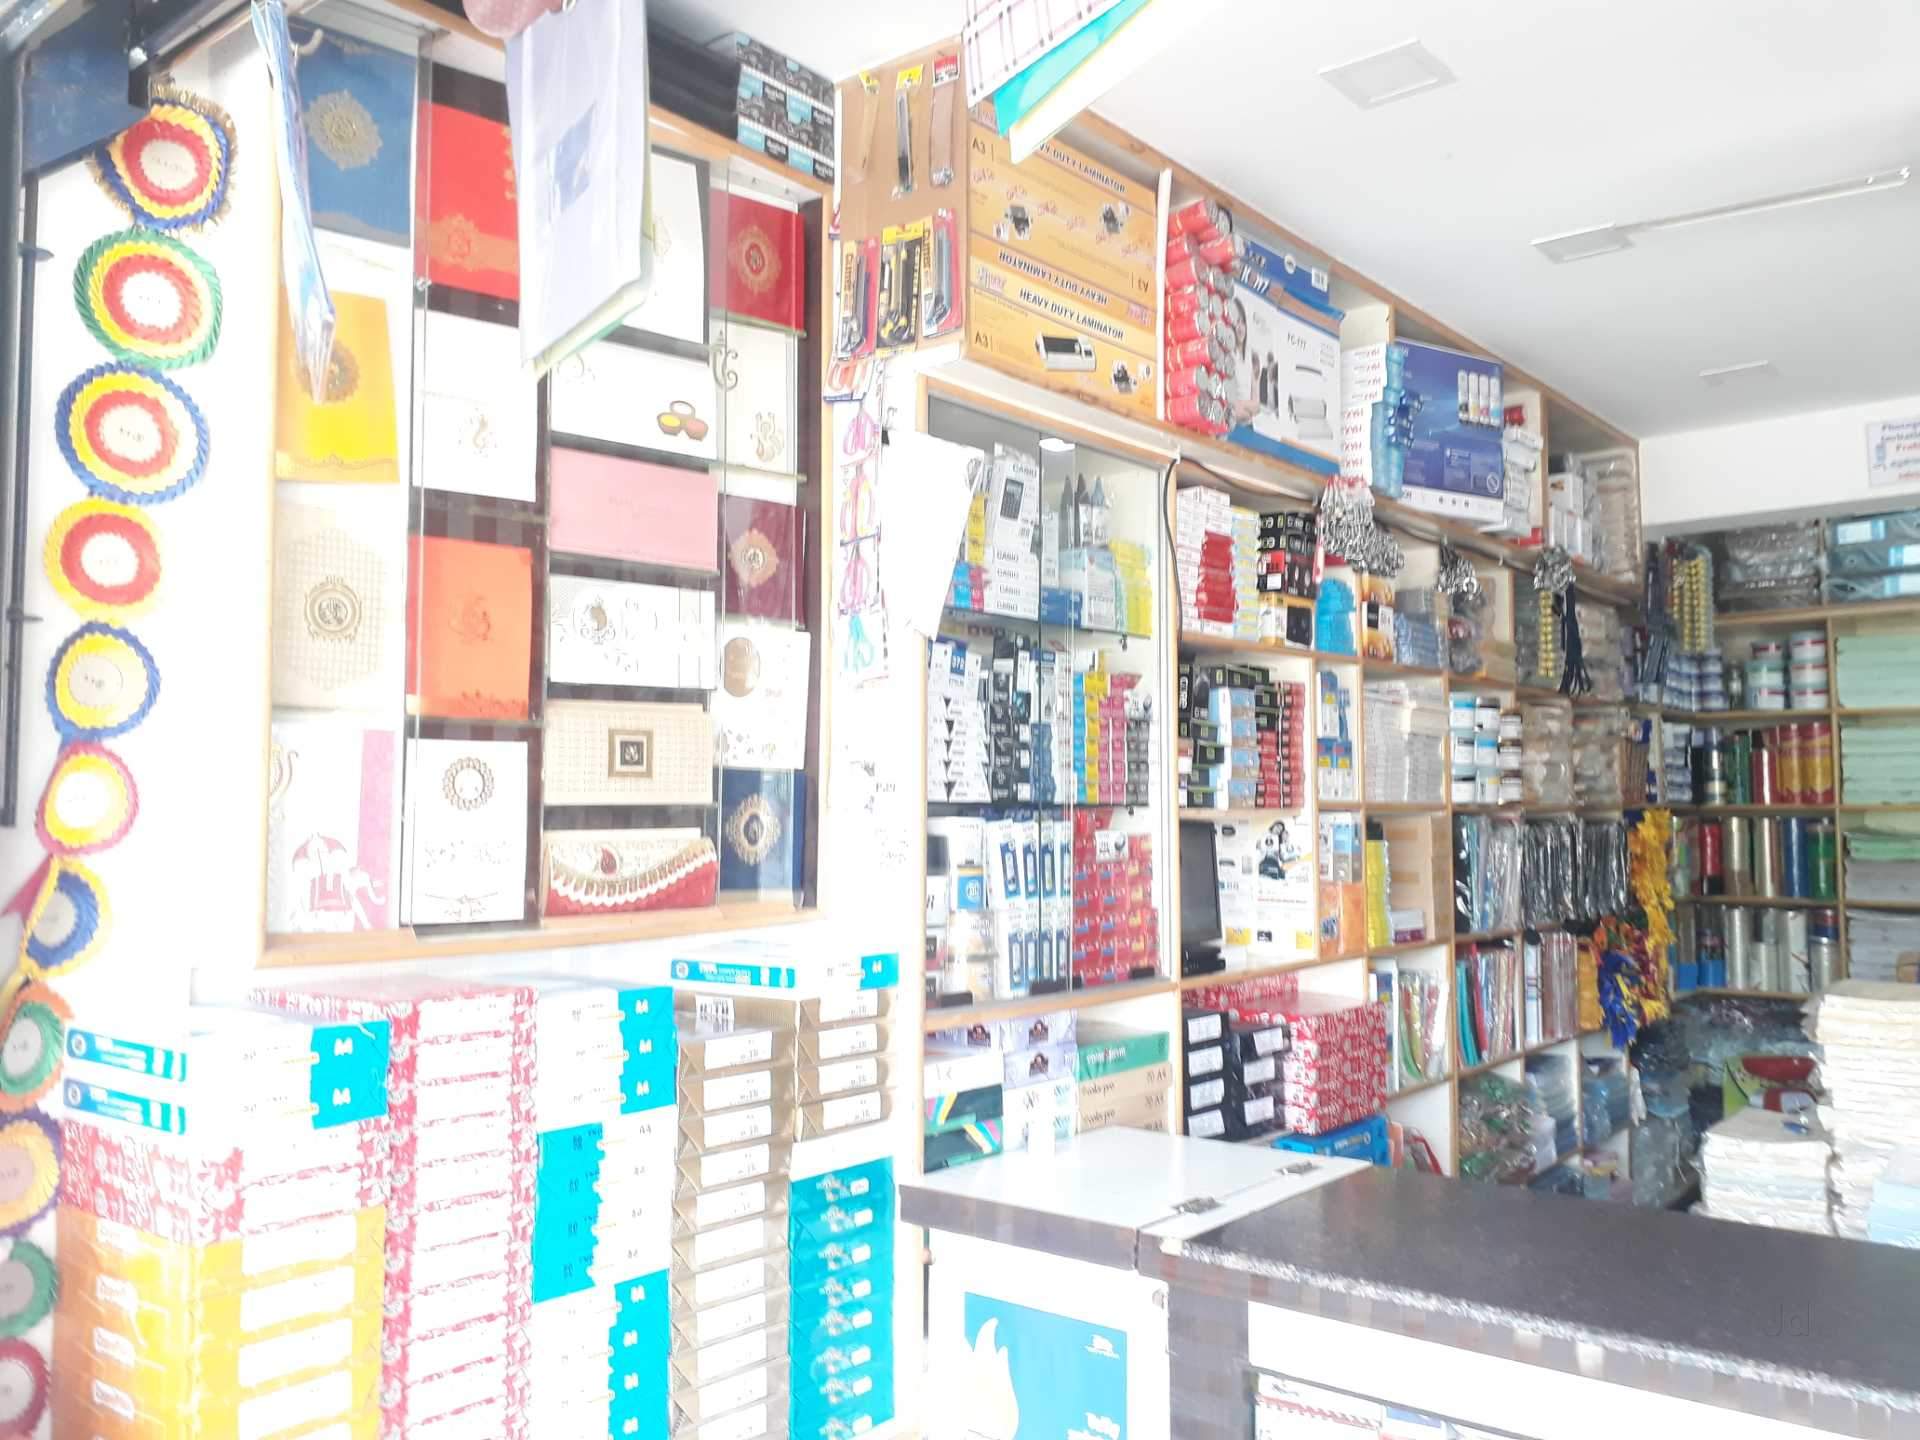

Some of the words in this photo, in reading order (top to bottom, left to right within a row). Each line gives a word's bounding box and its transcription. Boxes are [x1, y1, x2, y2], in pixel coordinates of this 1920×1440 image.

[1079, 162, 1126, 192] LAMINATOR
[999, 250, 1052, 280] LAMINATOR
[1055, 276, 1078, 292] DUTY
[1080, 287, 1108, 305] HEAVY
[1019, 287, 1049, 308] HEAVY
[1050, 302, 1075, 319] DUTY
[1076, 312, 1124, 340] LAMINATOR
[974, 330, 989, 349] A3
